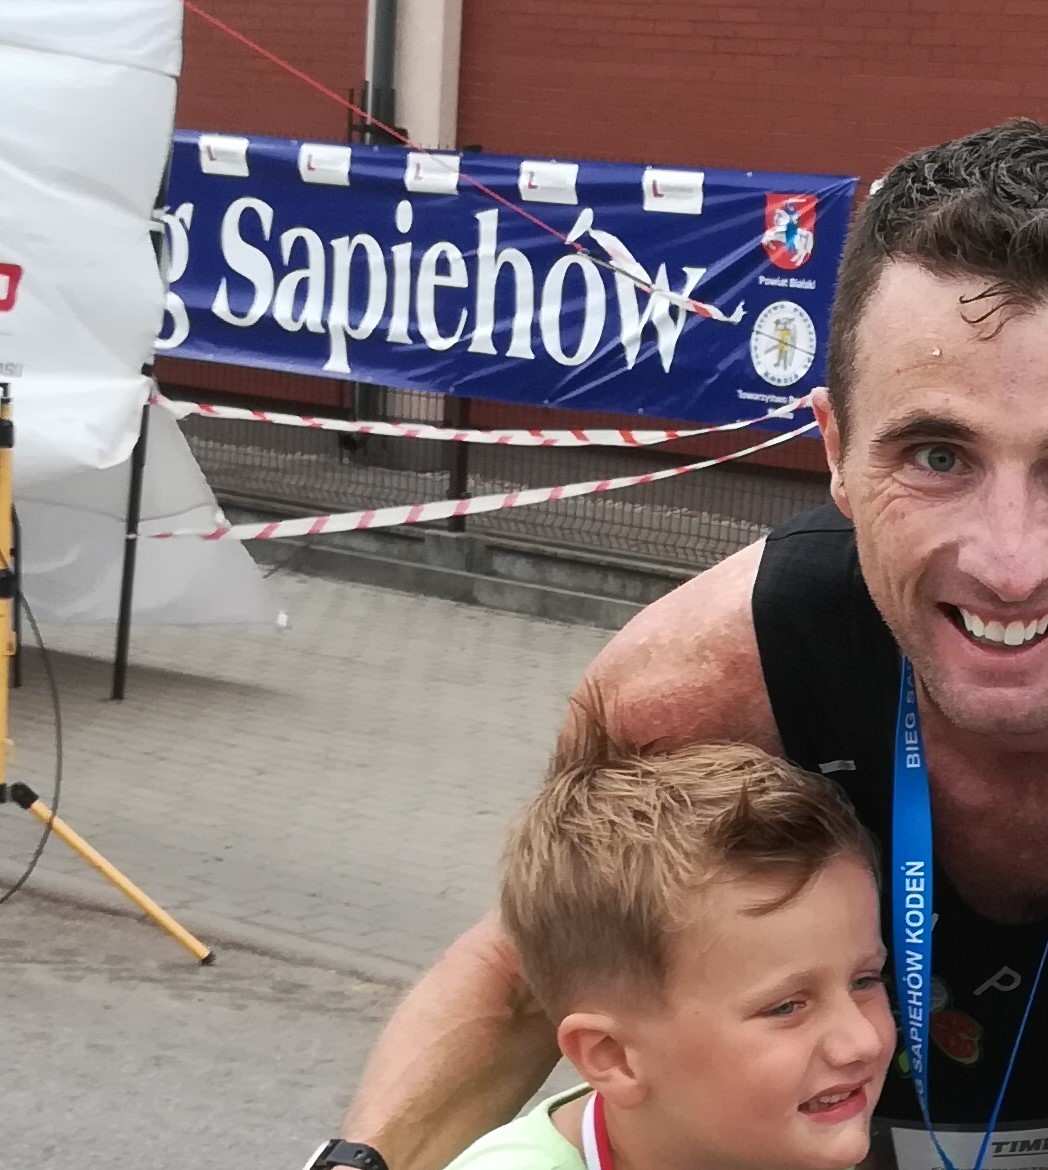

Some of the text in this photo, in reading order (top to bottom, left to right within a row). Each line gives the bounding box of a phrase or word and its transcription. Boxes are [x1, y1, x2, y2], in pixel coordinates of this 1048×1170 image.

[211, 196, 707, 374] Sapiehów
[904, 711, 922, 769] BIEG
[900, 860, 926, 944] KODEŃ
[903, 949, 924, 1073] SAPIEHÓW
